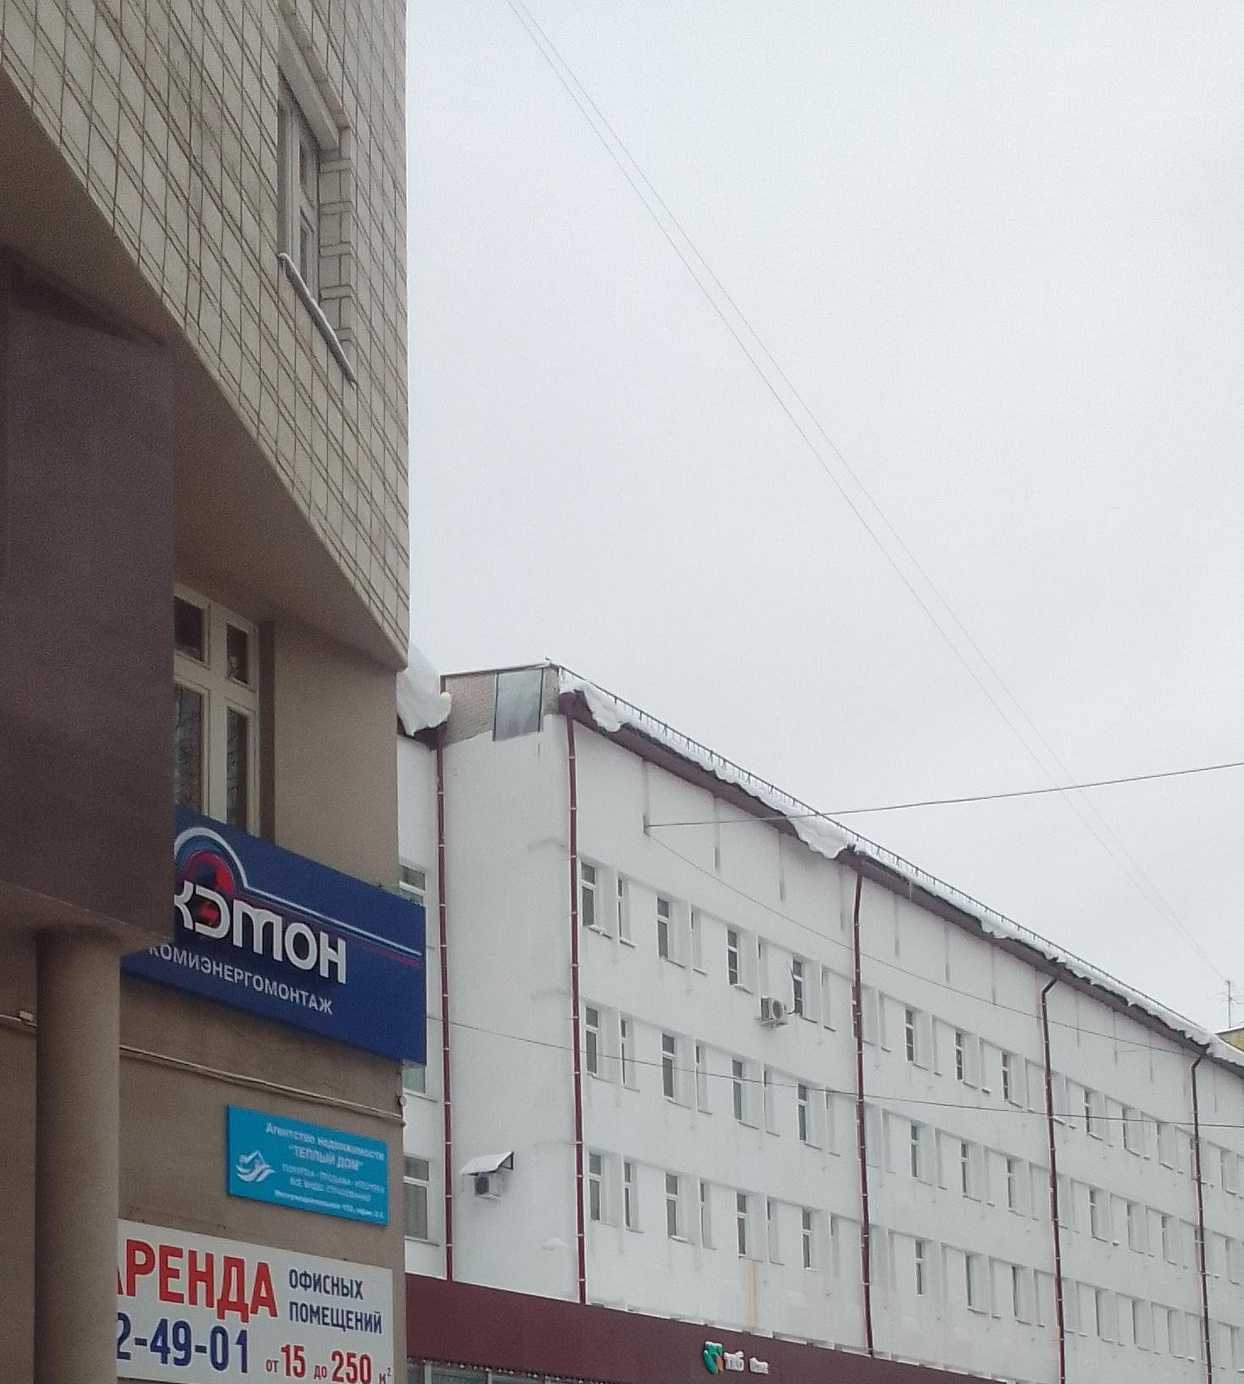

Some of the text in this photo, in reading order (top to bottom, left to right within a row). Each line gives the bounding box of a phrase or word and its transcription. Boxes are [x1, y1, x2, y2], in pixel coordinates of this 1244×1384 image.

[150, 944, 334, 1016] КОМИЭНЕРГОМОНТАЖ
[288, 1268, 364, 1301] ОФИСНЫХ
[288, 1301, 383, 1335] ПОМЕЩЕНИЙ
[117, 1311, 248, 1374] 2-49-01
[265, 1357, 279, 1373] от
[281, 1343, 305, 1378] 15
[313, 1364, 328, 1380] до
